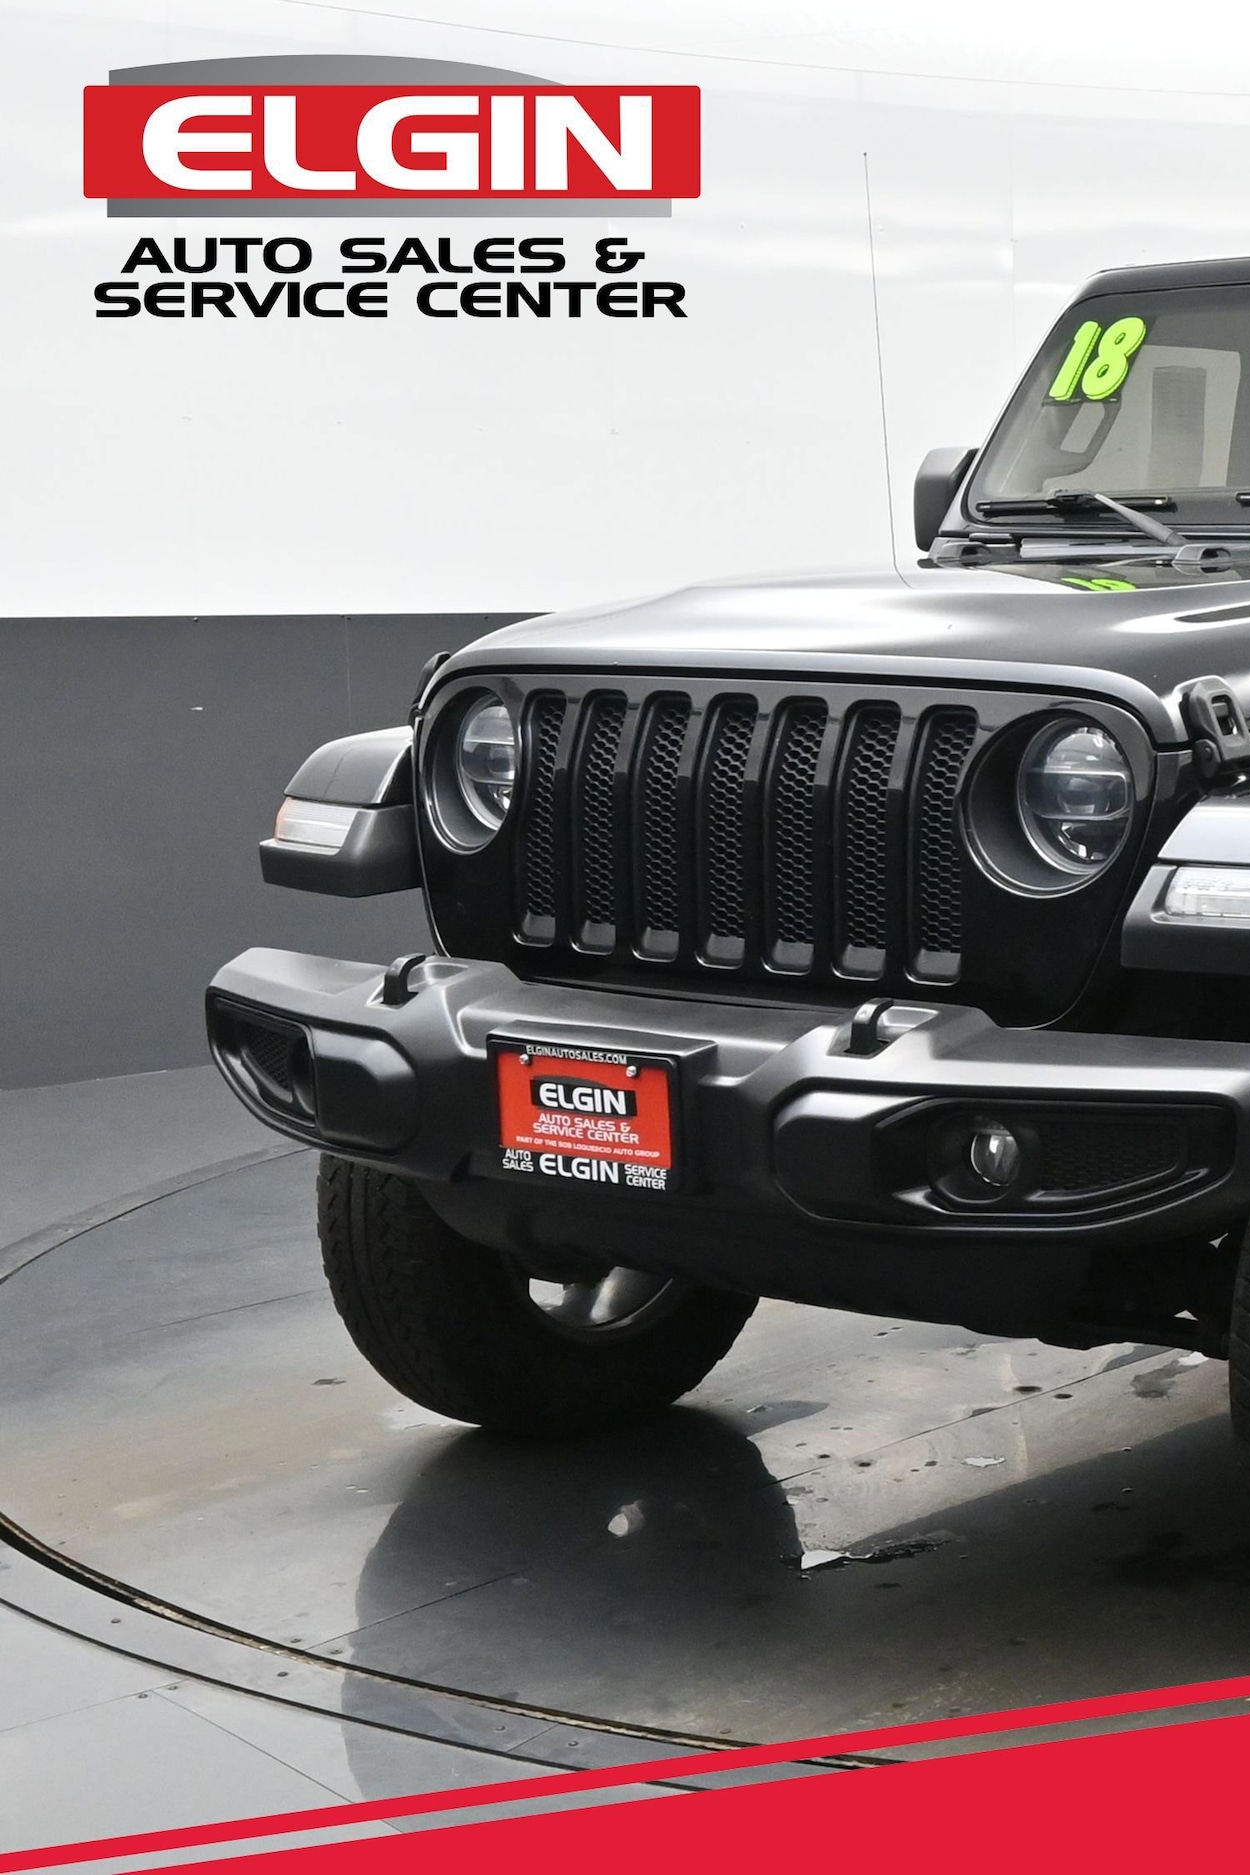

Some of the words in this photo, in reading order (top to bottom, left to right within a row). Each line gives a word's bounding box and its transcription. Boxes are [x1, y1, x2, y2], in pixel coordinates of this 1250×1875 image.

[1048, 316, 1147, 401] 18
[526, 1045, 628, 1065] ELGINAUTOSALES.COM
[539, 1082, 627, 1115] ELGIN
[533, 1122, 584, 1139] SERVICE
[587, 1129, 640, 1144] CENTER
[538, 1113, 571, 1126] AUTO
[574, 1117, 616, 1132] SALES
[620, 1122, 631, 1133] &
[505, 1148, 531, 1161] AUTO
[613, 1148, 633, 1156] AUTO
[502, 1159, 534, 1172] SALES
[539, 1153, 619, 1184] ELGIN
[624, 1163, 667, 1180] SERVICE
[626, 1175, 666, 1191] CENTER
